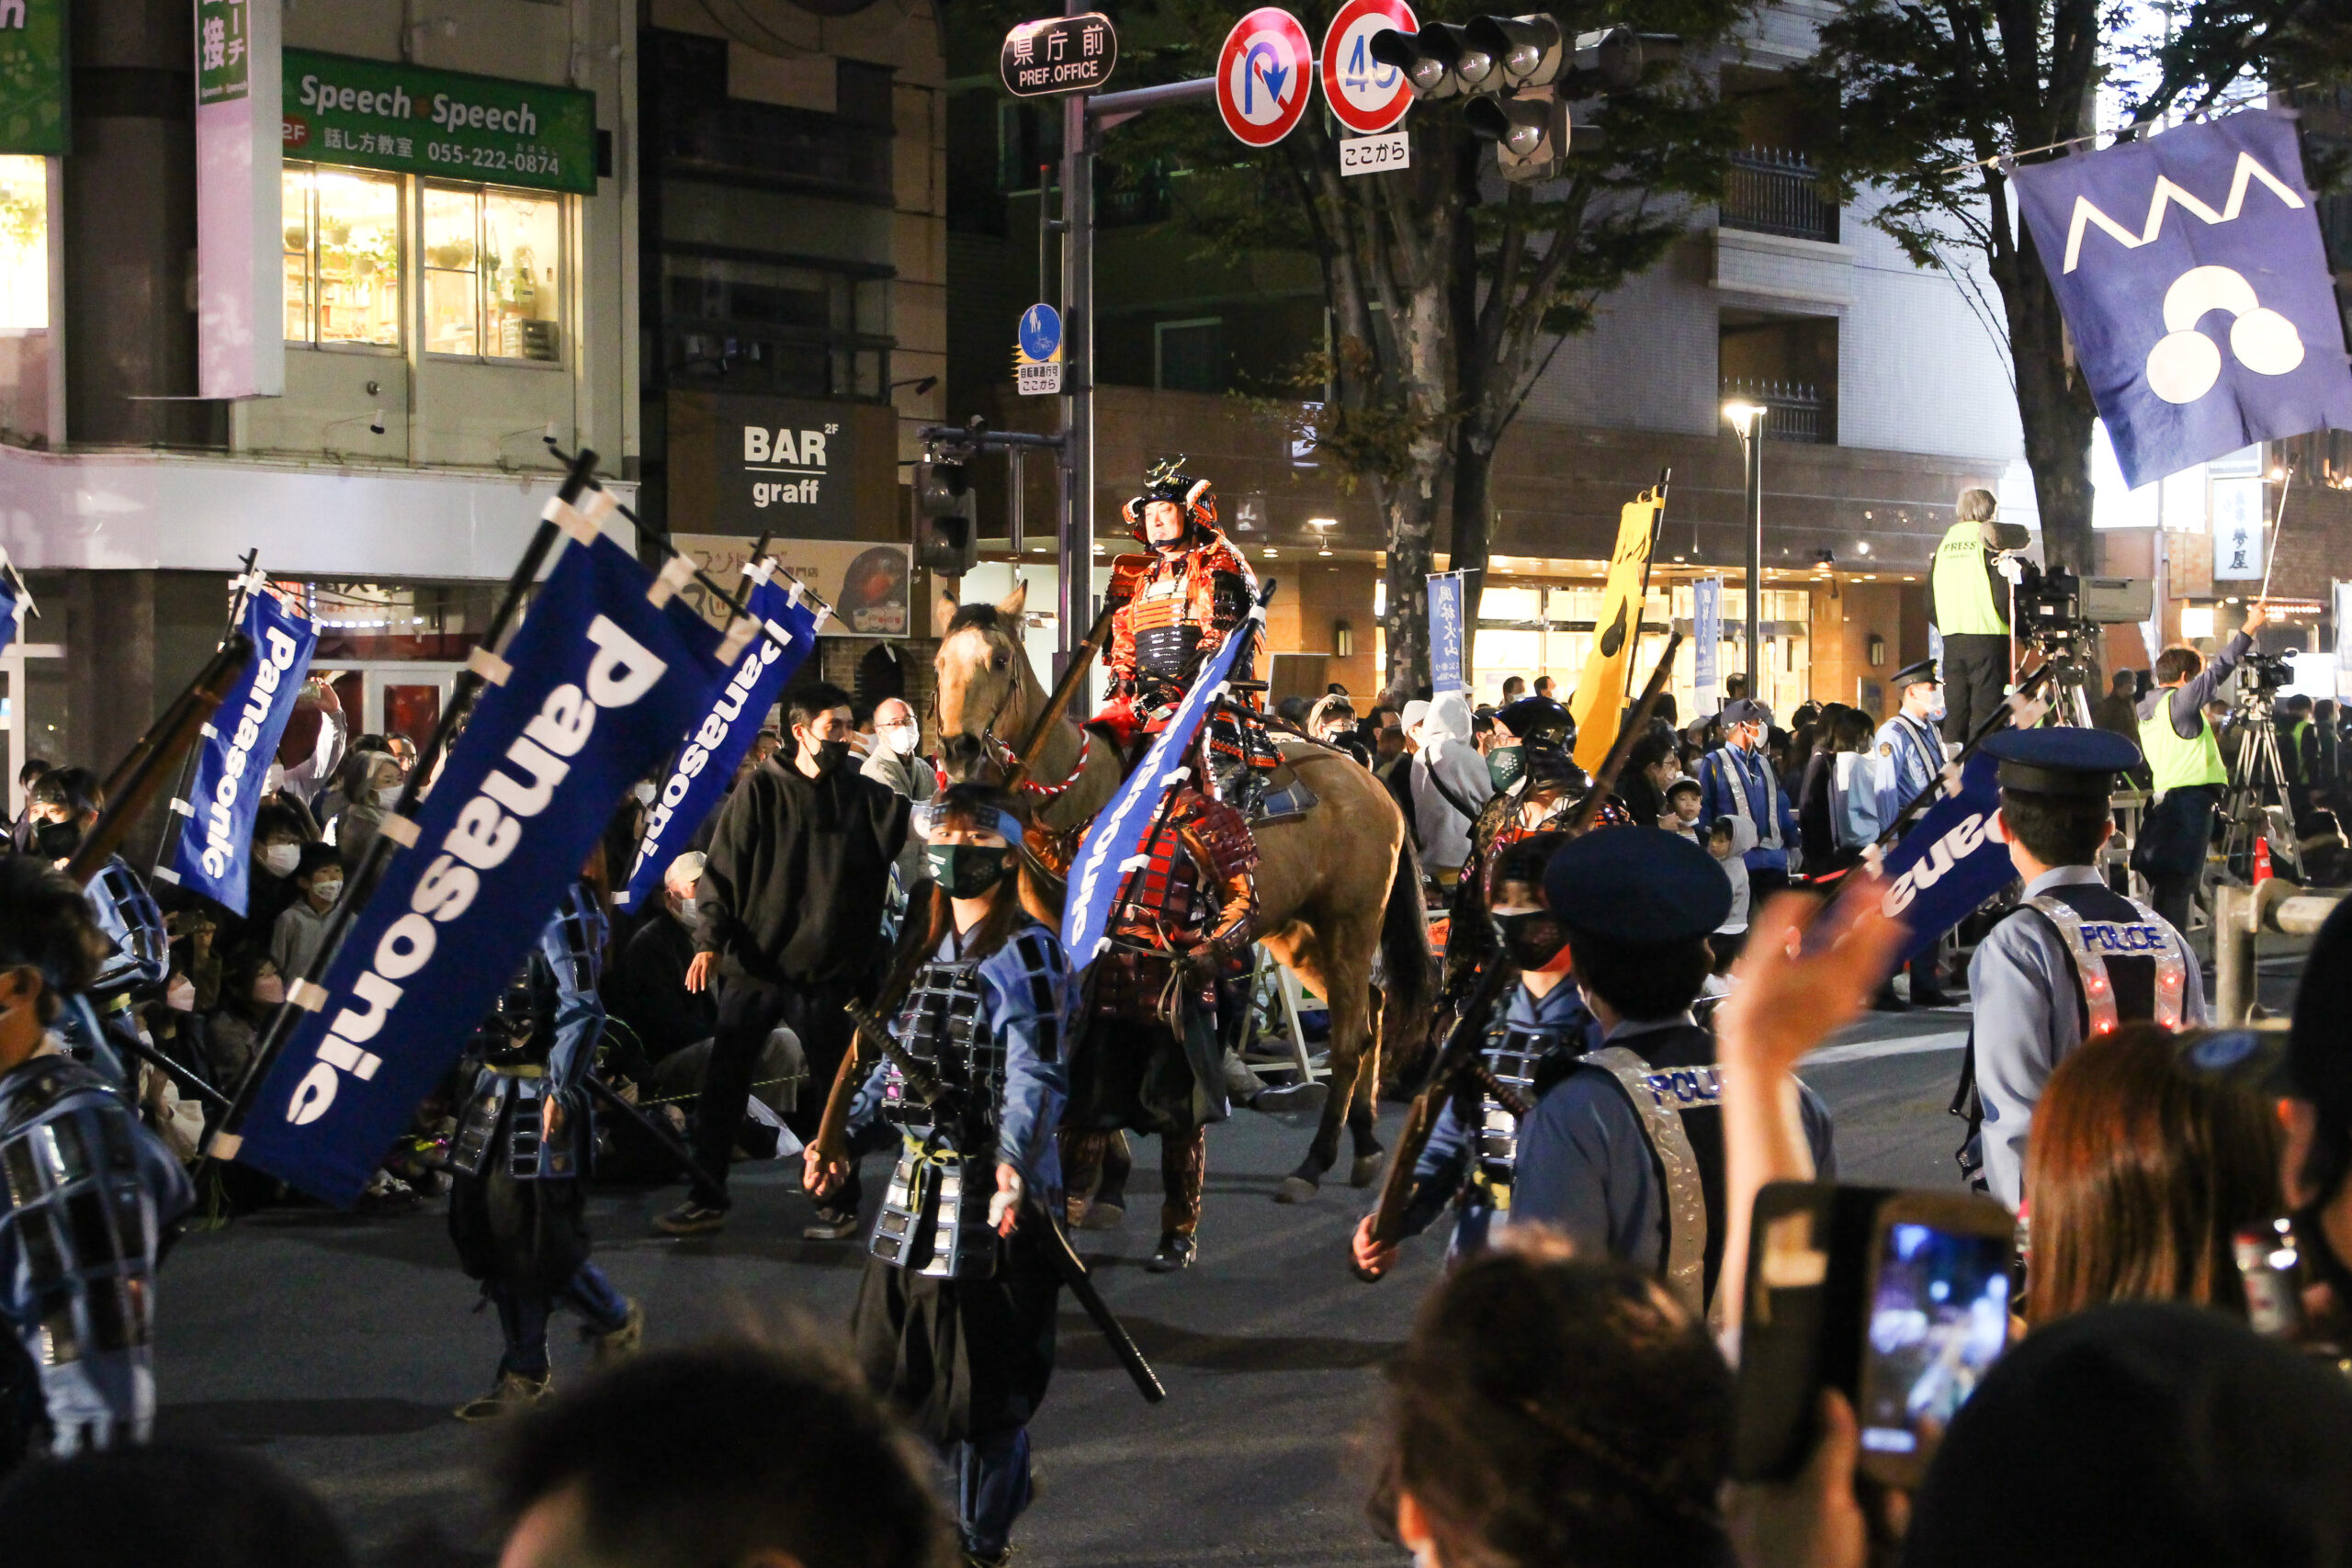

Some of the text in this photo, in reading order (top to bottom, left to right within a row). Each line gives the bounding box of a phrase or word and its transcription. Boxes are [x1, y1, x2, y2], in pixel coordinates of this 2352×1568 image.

[1013, 24, 1104, 67] 県庁前
[300, 74, 537, 136] Speech Speech
[323, 127, 560, 176] 話し方教室 055-222-0874
[1345, 141, 1406, 167] ここから
[1023, 379, 1057, 391] ここから
[744, 423, 840, 467] BAR 2F
[752, 479, 820, 508] graff
[1943, 540, 1977, 552] PRESS
[204, 626, 297, 879] Panasonic
[285, 614, 668, 1126] Panasonic
[2078, 924, 2166, 952] POLICE
[1647, 1069, 1721, 1105] POLI
